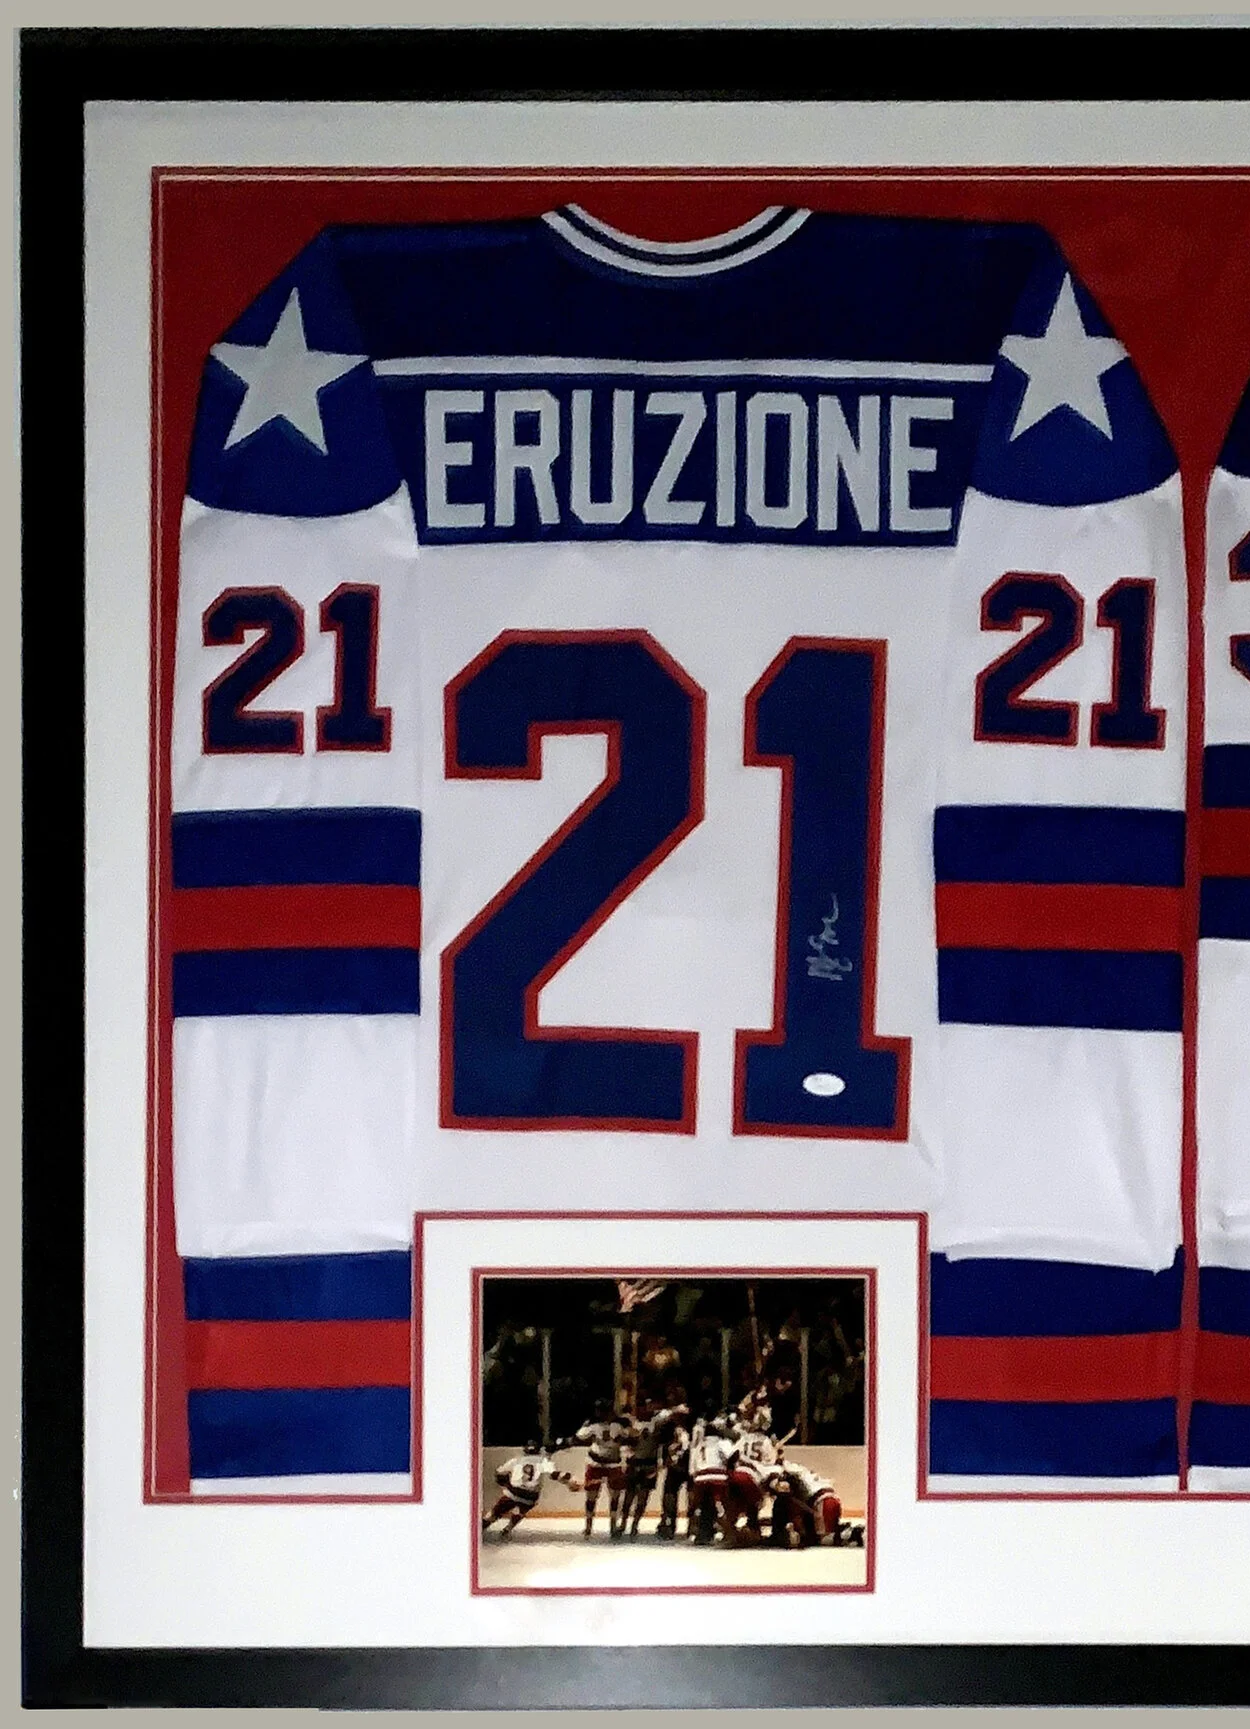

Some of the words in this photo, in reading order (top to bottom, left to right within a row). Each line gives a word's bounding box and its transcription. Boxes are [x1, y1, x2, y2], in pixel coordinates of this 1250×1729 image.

[422, 388, 955, 535] ERUZIONE
[202, 582, 392, 756] 21
[974, 571, 1167, 751] 21
[439, 628, 913, 1143] 21
